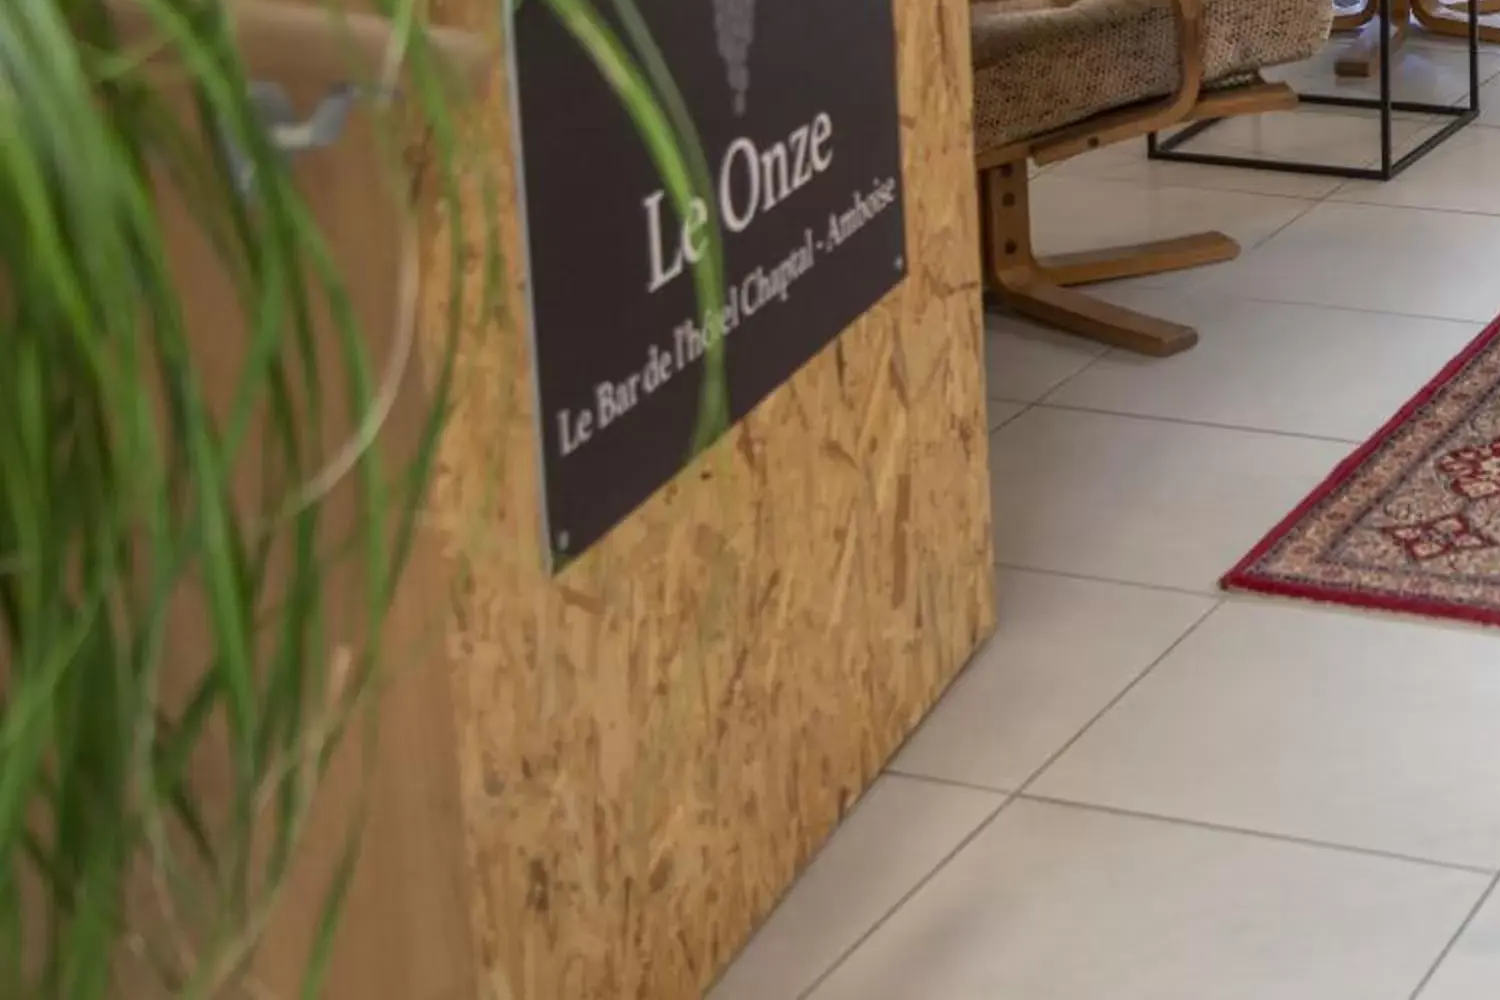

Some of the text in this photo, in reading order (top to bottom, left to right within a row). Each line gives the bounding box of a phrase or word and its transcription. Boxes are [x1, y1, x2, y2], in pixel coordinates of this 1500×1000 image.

[556, 408, 594, 457] Le
[595, 372, 641, 430] Bar
[641, 343, 674, 394] de
[740, 226, 815, 316] Chaptal
[824, 175, 896, 253] Amboise
[642, 111, 833, 294] Le Onze
